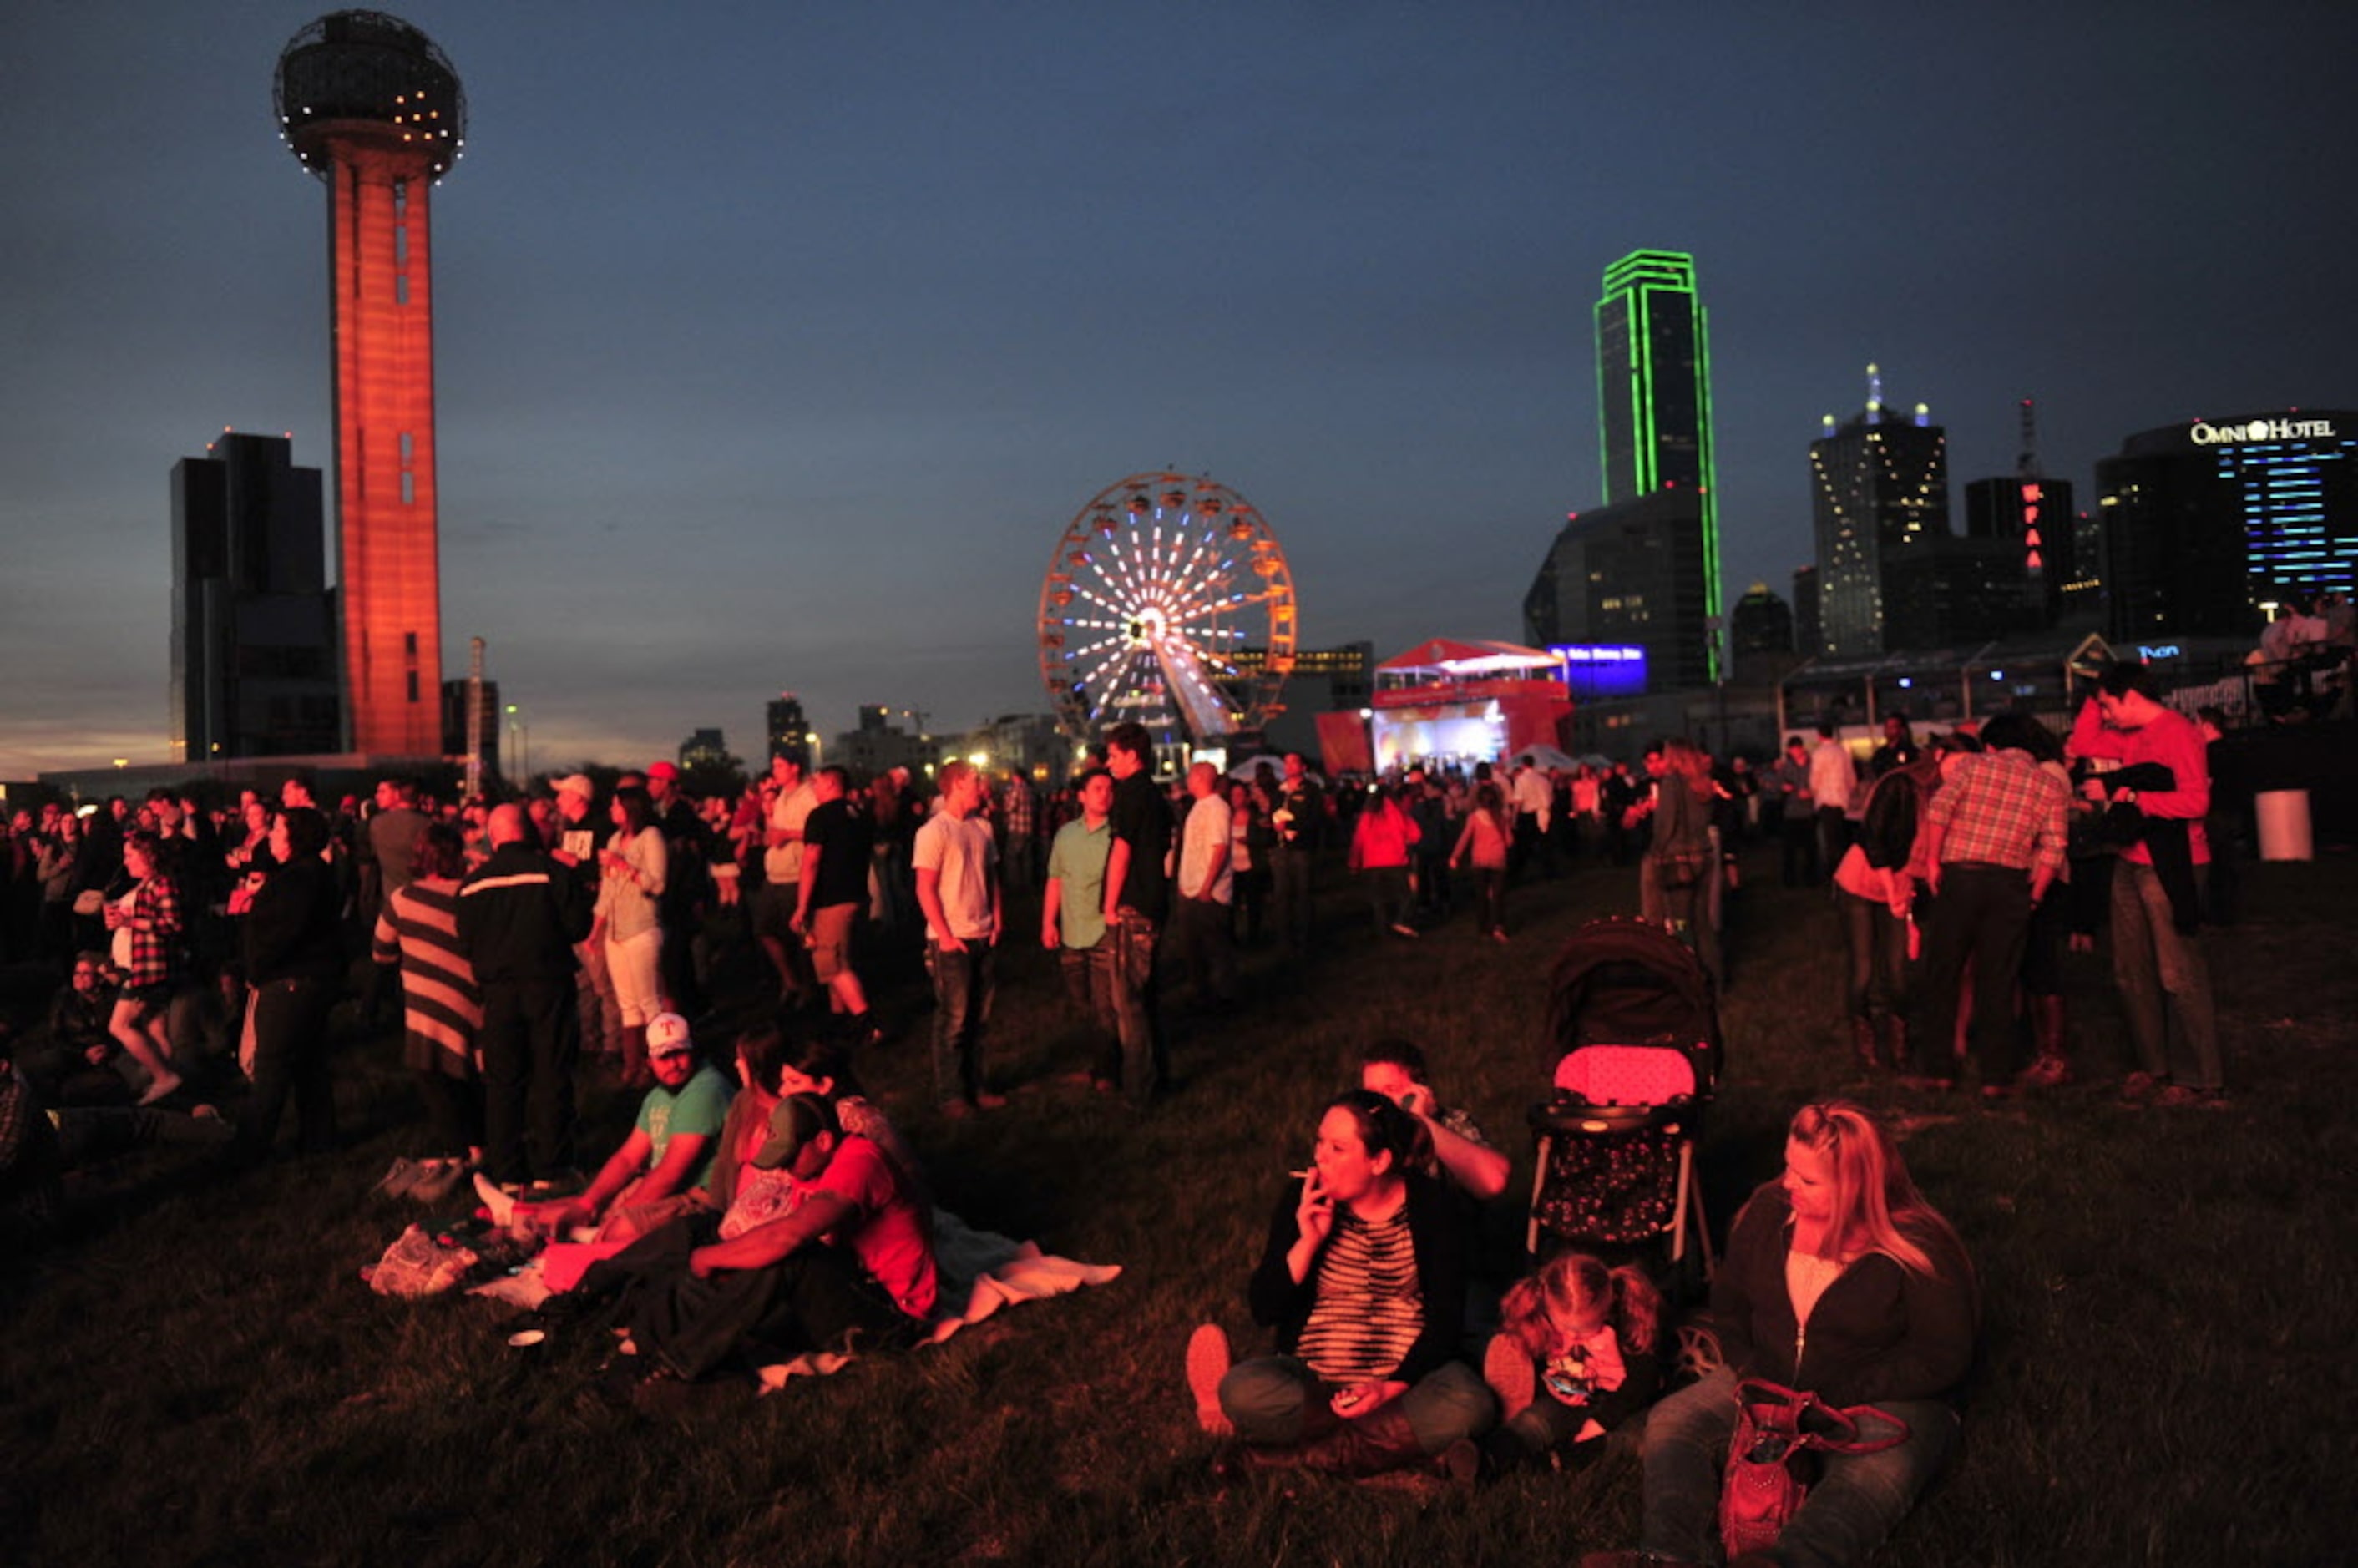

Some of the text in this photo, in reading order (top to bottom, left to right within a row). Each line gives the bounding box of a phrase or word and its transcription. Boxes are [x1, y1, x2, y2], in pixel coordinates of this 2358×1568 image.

[2190, 418, 2336, 445] OMNI HOTEL
[660, 1019, 676, 1036] T
